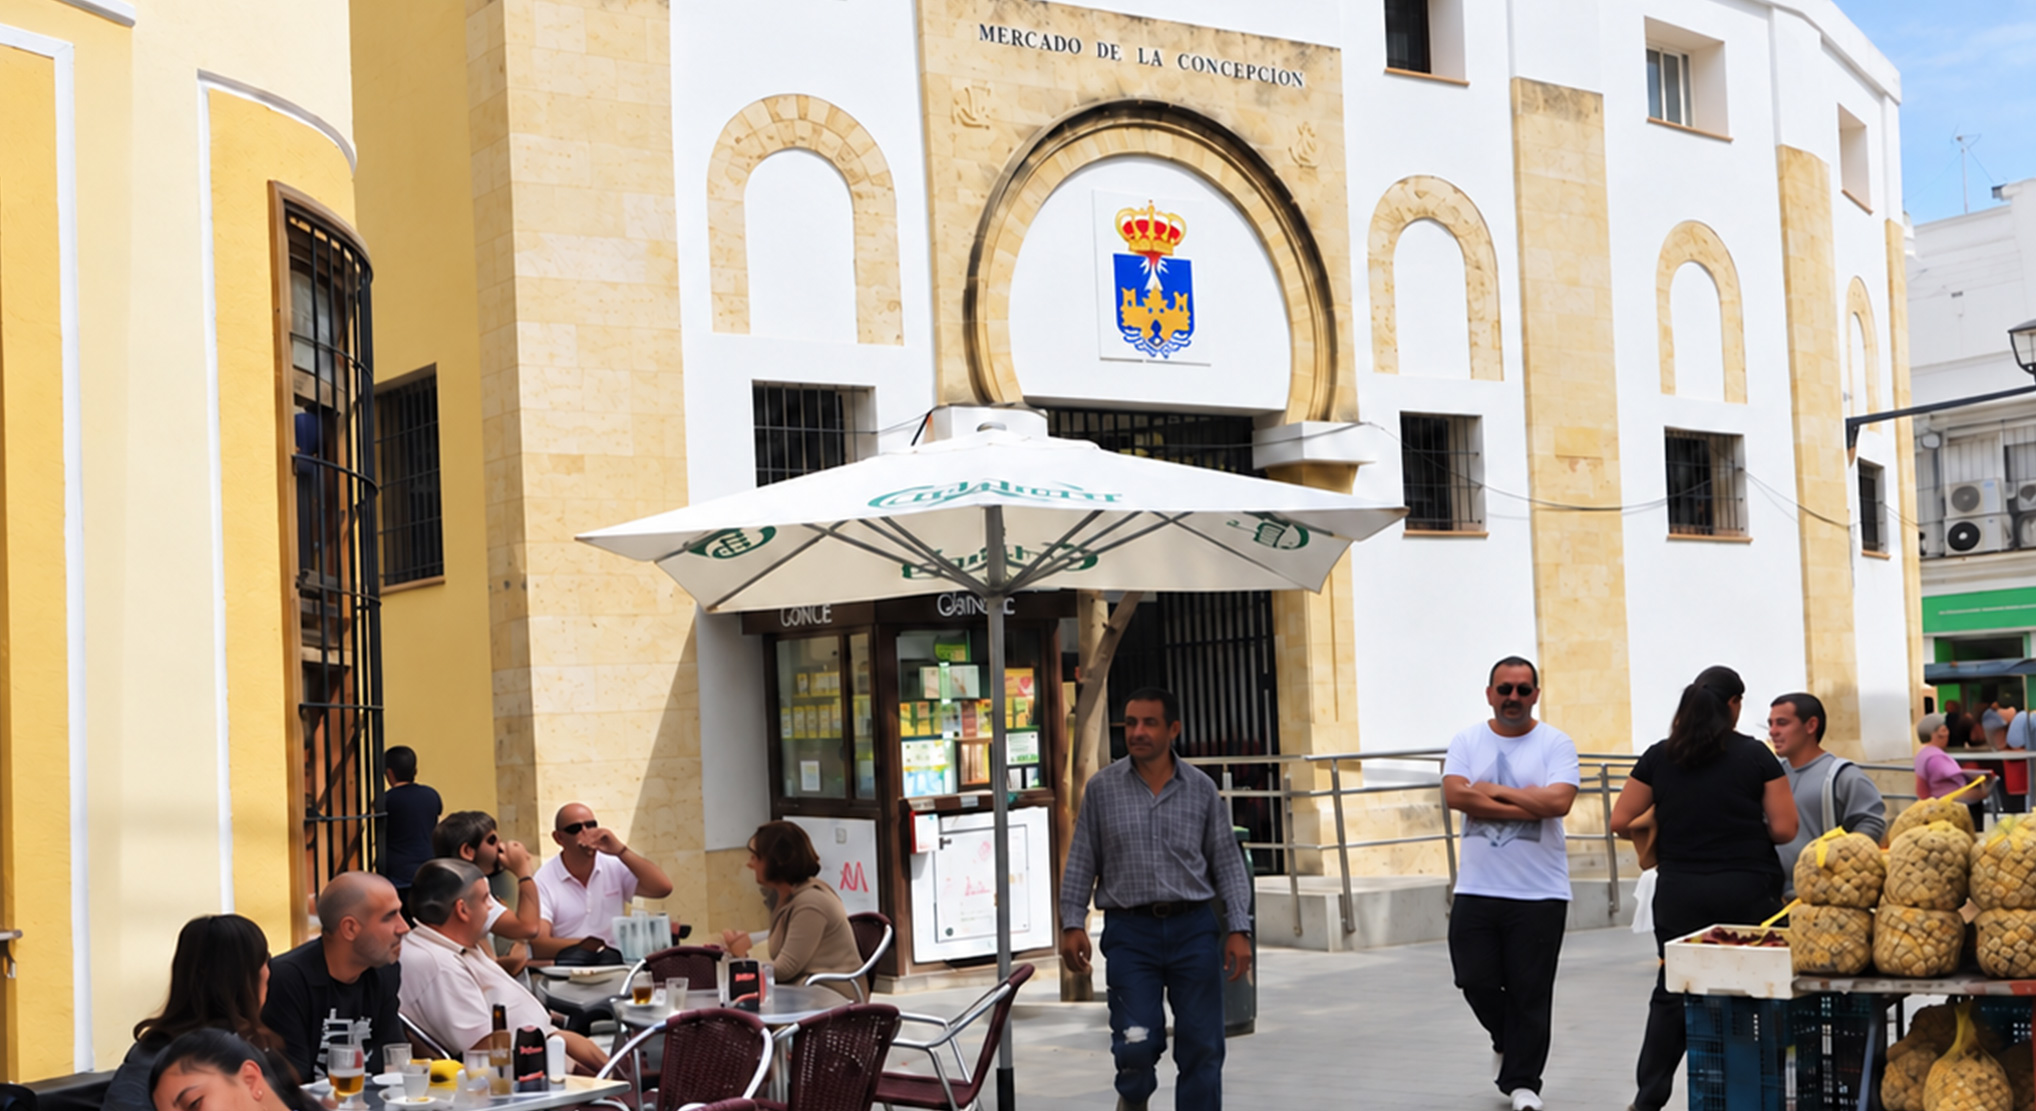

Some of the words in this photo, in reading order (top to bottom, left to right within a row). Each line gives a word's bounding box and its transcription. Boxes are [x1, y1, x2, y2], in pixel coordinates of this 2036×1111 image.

[979, 23, 1082, 55] MERCADO
[1096, 41, 1122, 62] DE
[1137, 47, 1163, 67] LA
[1177, 53, 1304, 88] CONCEPCION
